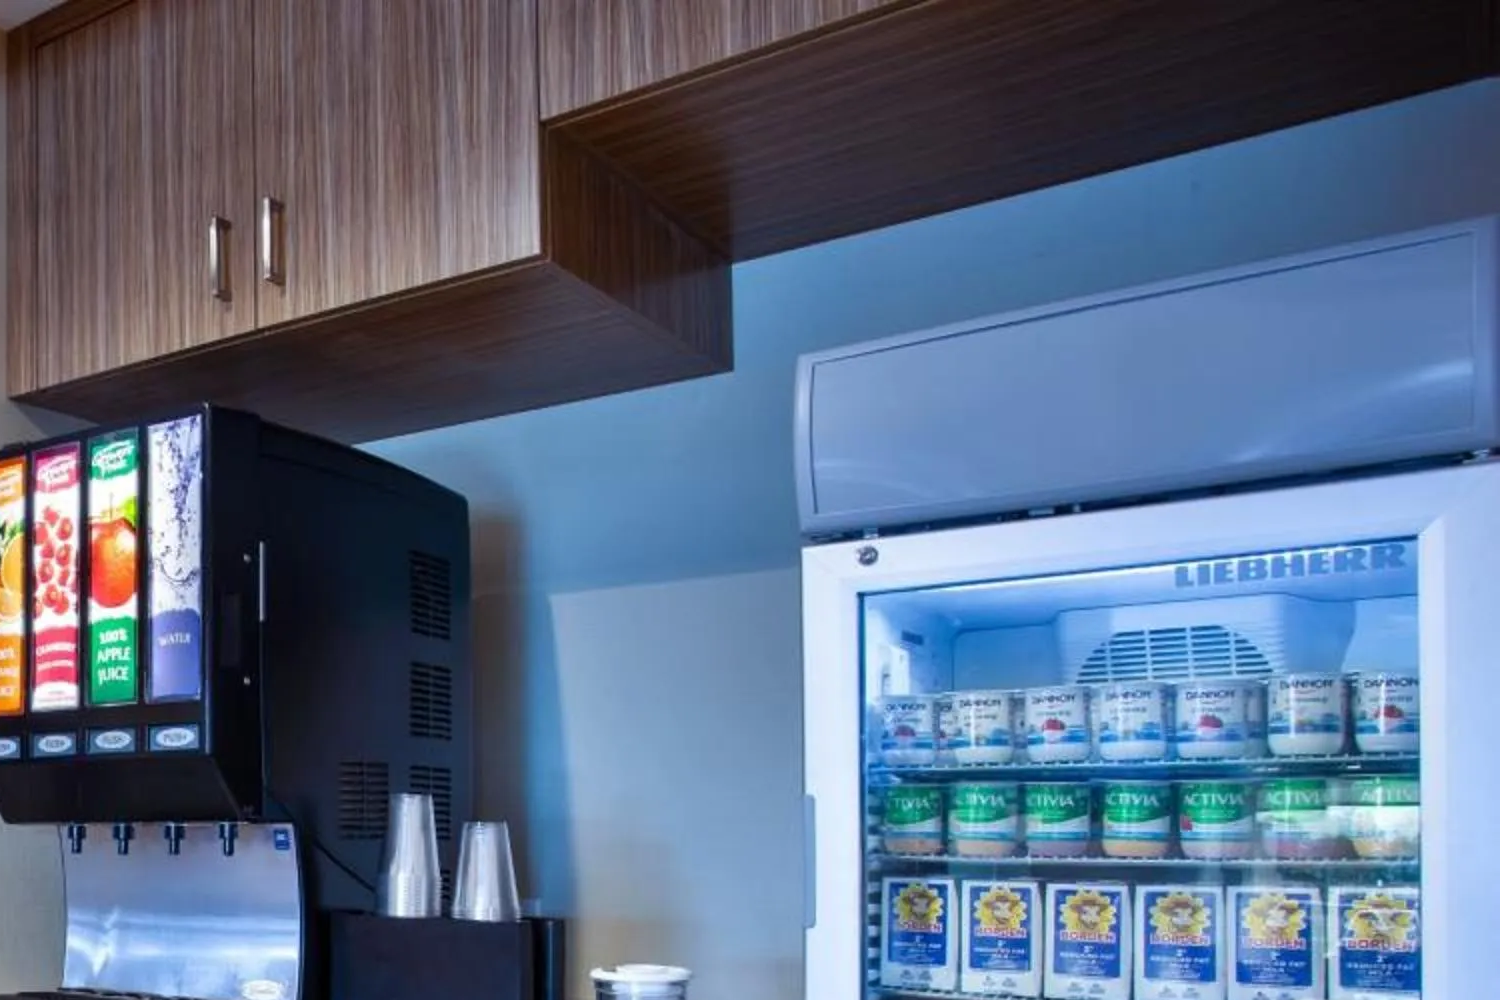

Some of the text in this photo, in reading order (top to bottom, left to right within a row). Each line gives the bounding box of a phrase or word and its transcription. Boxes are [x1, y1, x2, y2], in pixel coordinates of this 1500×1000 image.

[1174, 544, 1406, 588] LIEBHERR
[97, 647, 131, 664] APPLE
[98, 666, 130, 686] JUICE
[1184, 792, 1243, 806] ACTIVIA
